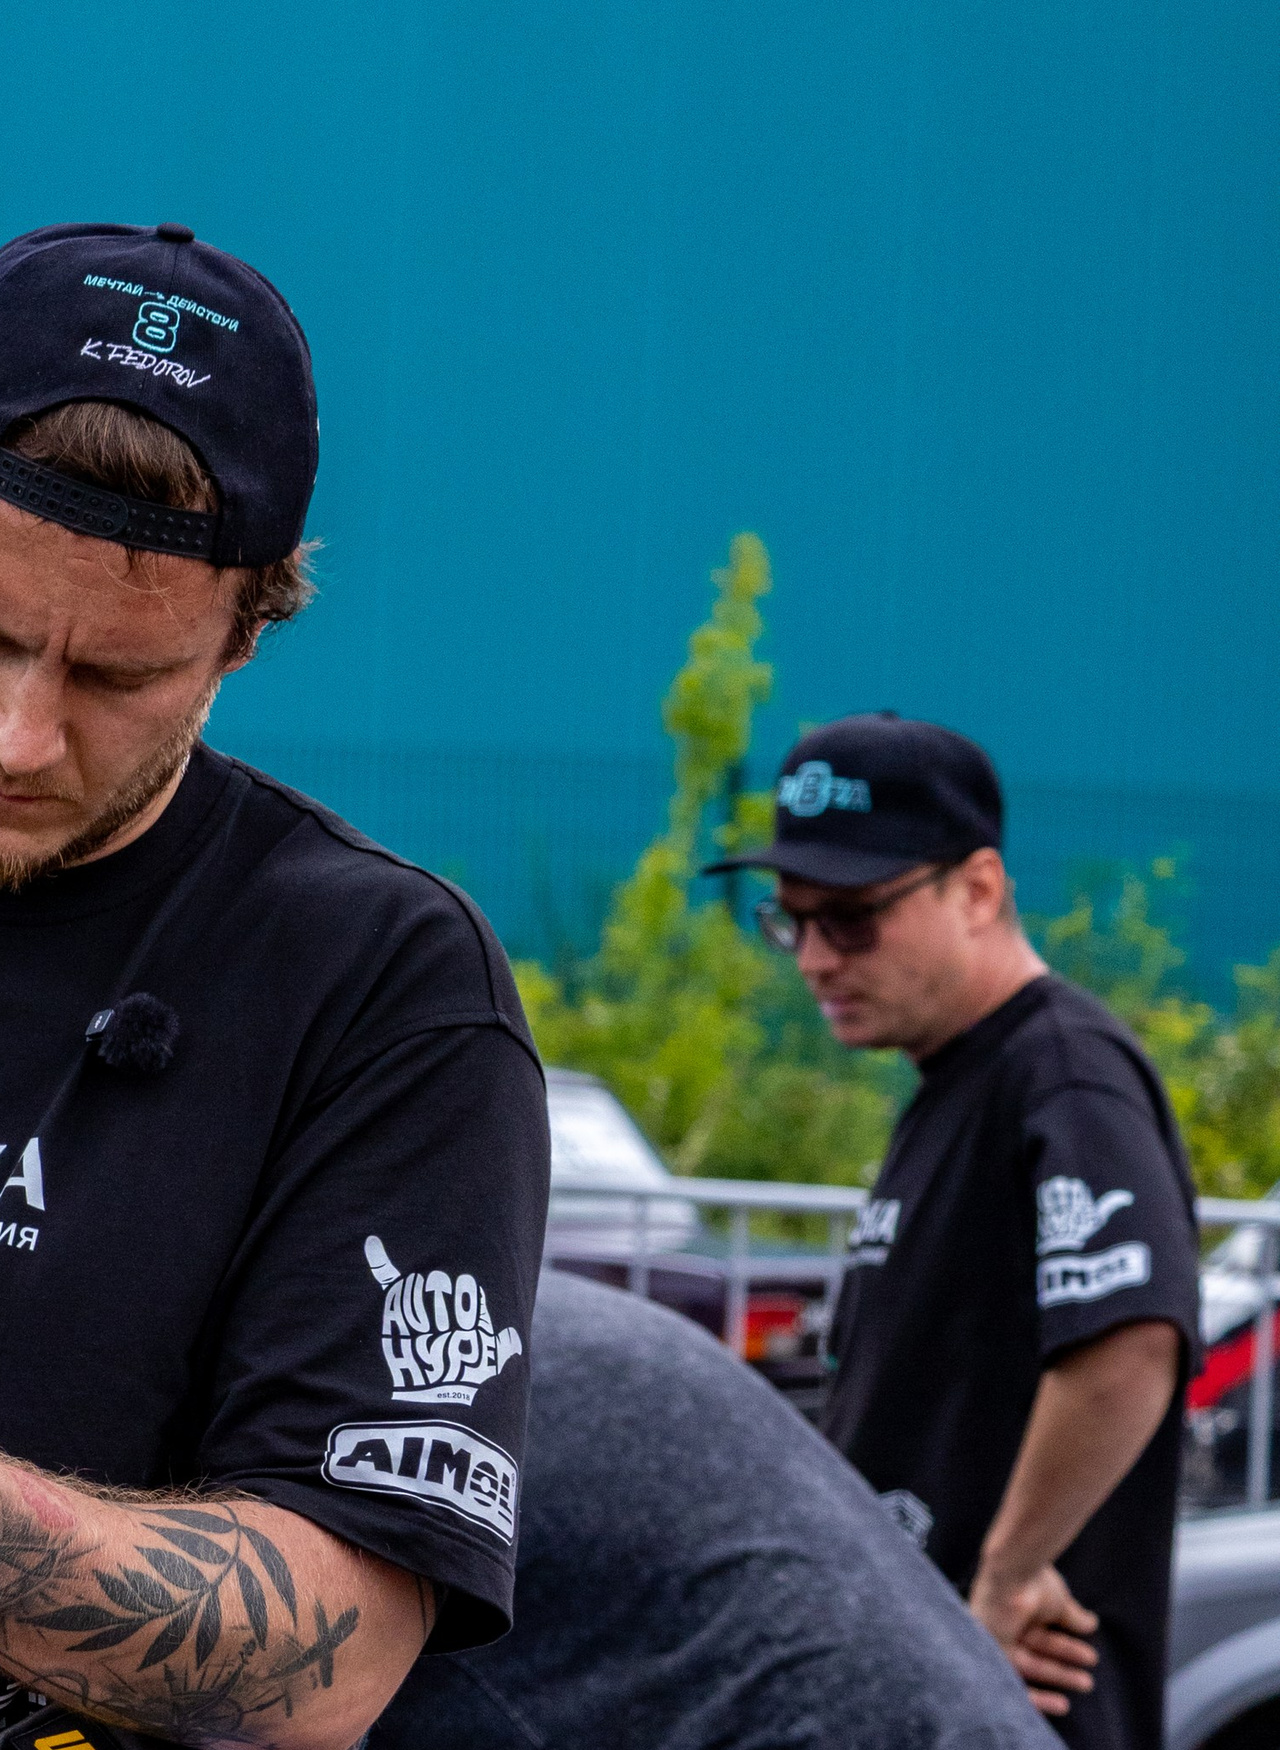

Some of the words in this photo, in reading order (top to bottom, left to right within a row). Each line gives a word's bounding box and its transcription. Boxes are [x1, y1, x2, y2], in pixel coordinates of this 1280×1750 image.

[83, 274, 144, 297] МЕЧТАЙ
[166, 294, 240, 332] ДЕЙСТВУЙ
[132, 301, 180, 353] 8
[381, 1269, 478, 1335] AUTO
[381, 1329, 498, 1388] HYPE
